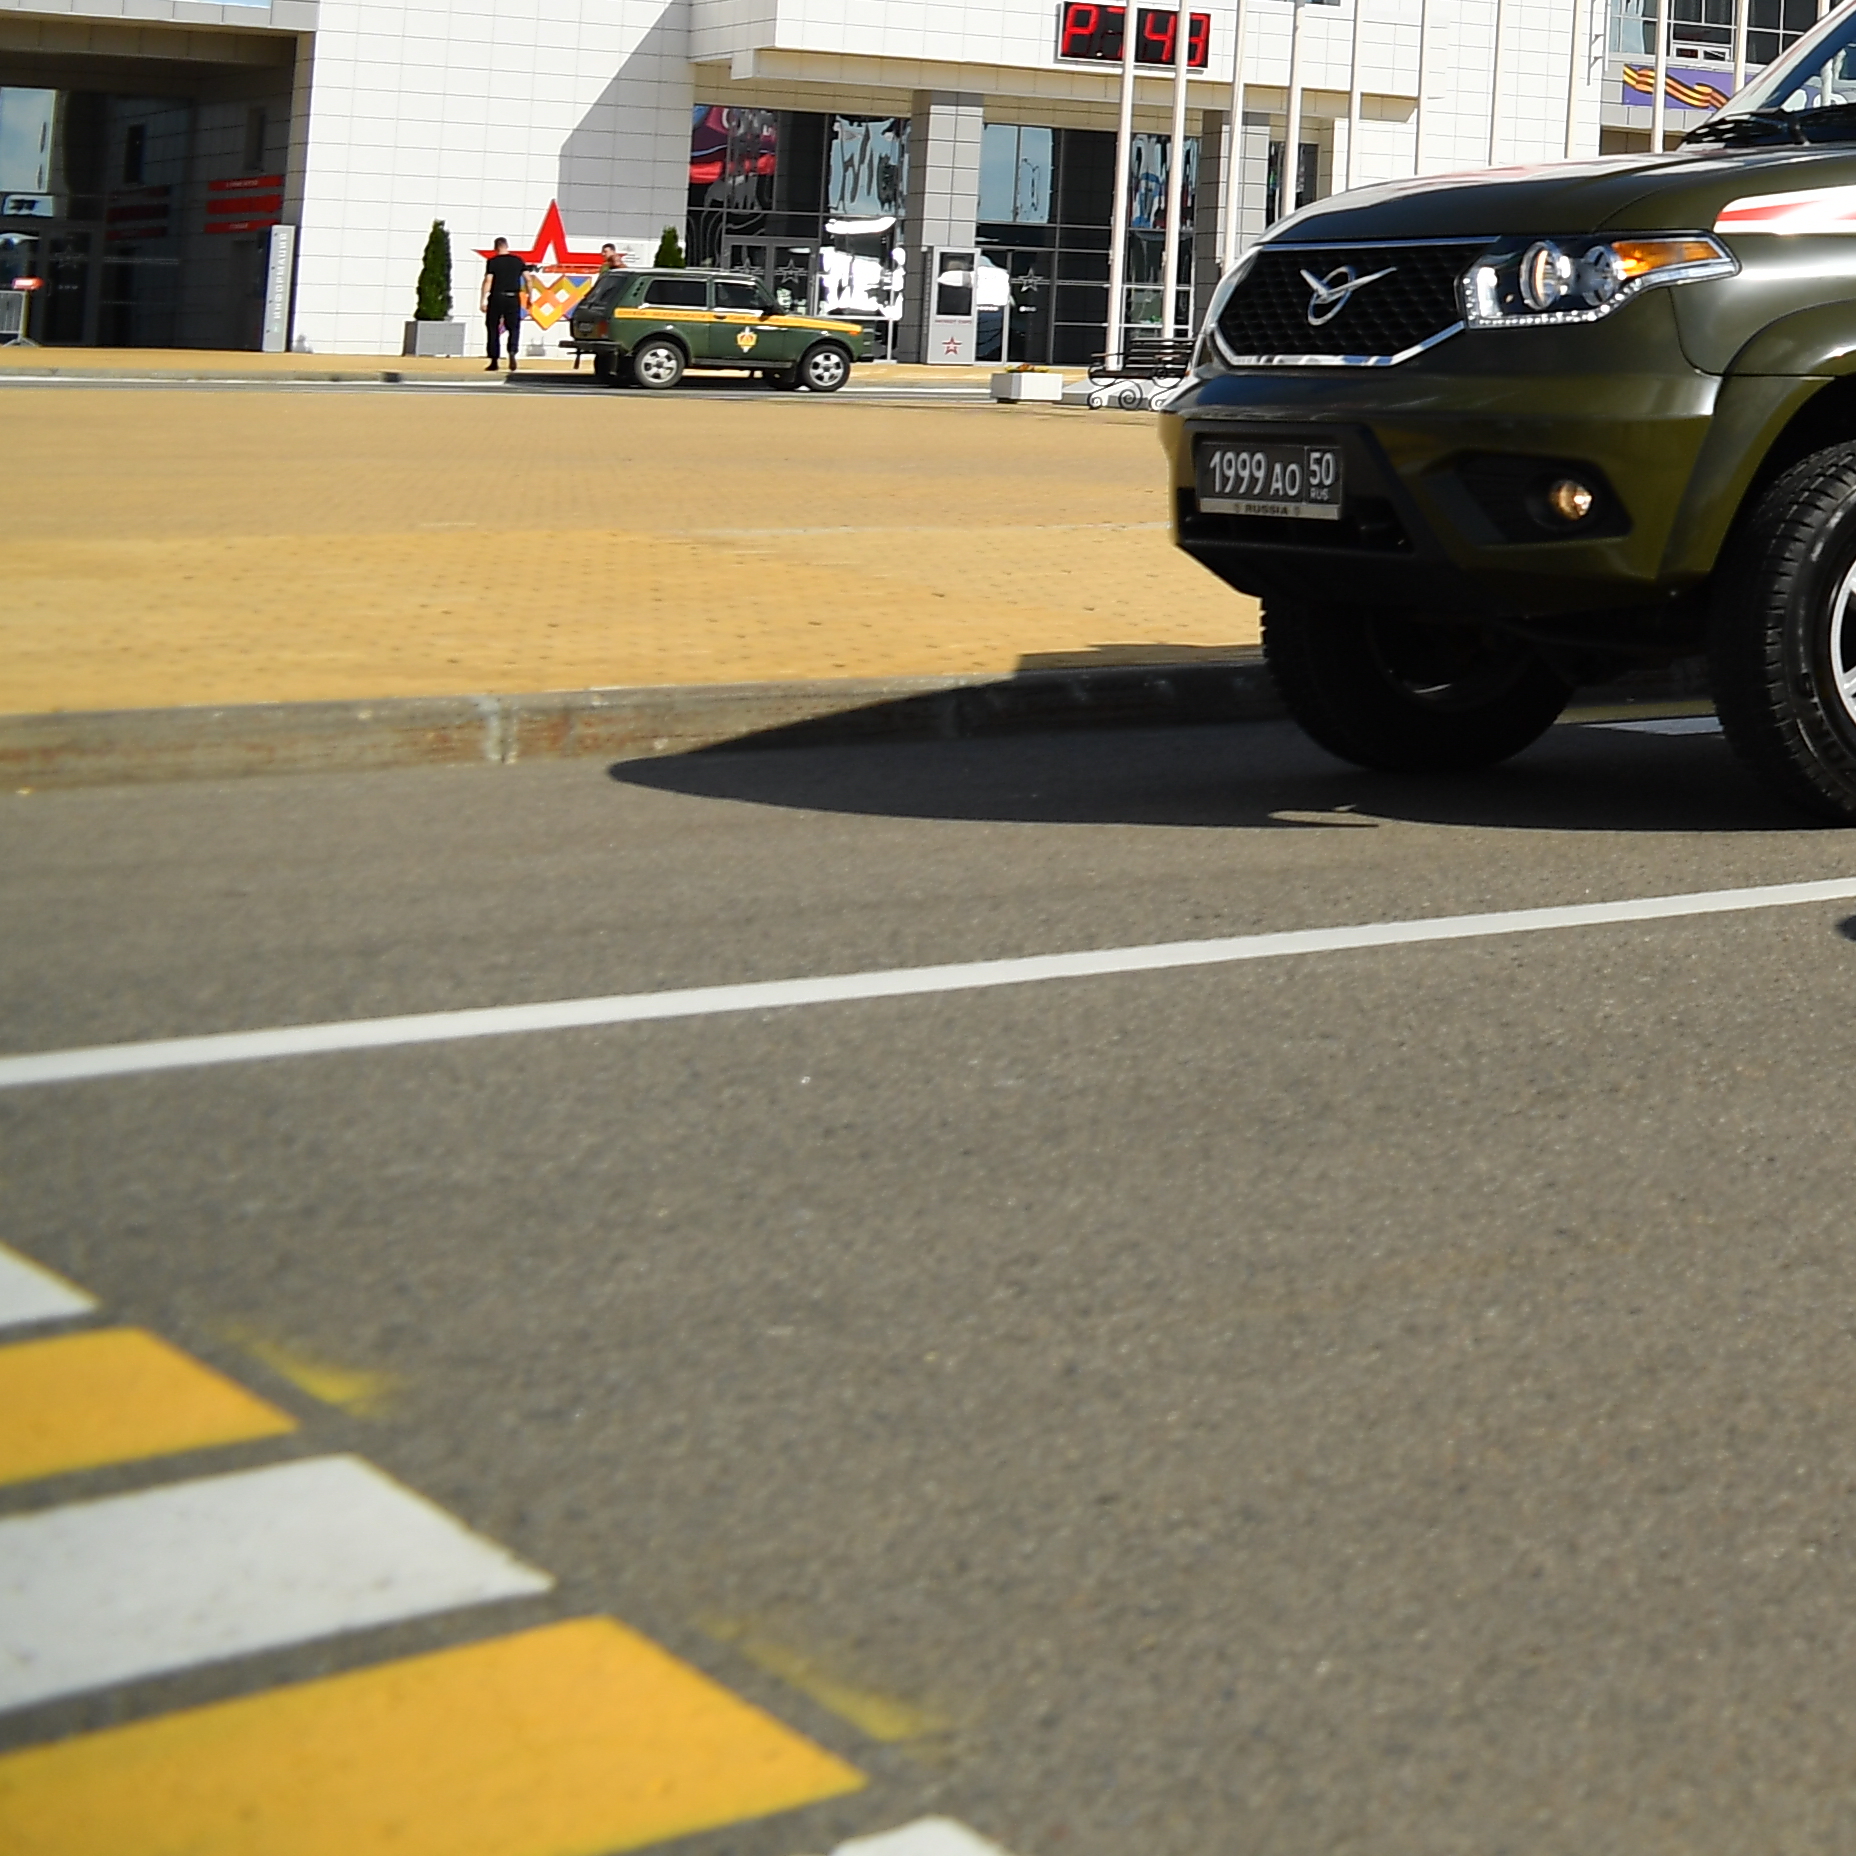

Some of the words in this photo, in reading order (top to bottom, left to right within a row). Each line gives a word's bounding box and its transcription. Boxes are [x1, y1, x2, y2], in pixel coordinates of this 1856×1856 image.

[1209, 450, 1266, 495] 1999
[1308, 452, 1335, 486] 50
[1244, 504, 1288, 515] RUSSIA
